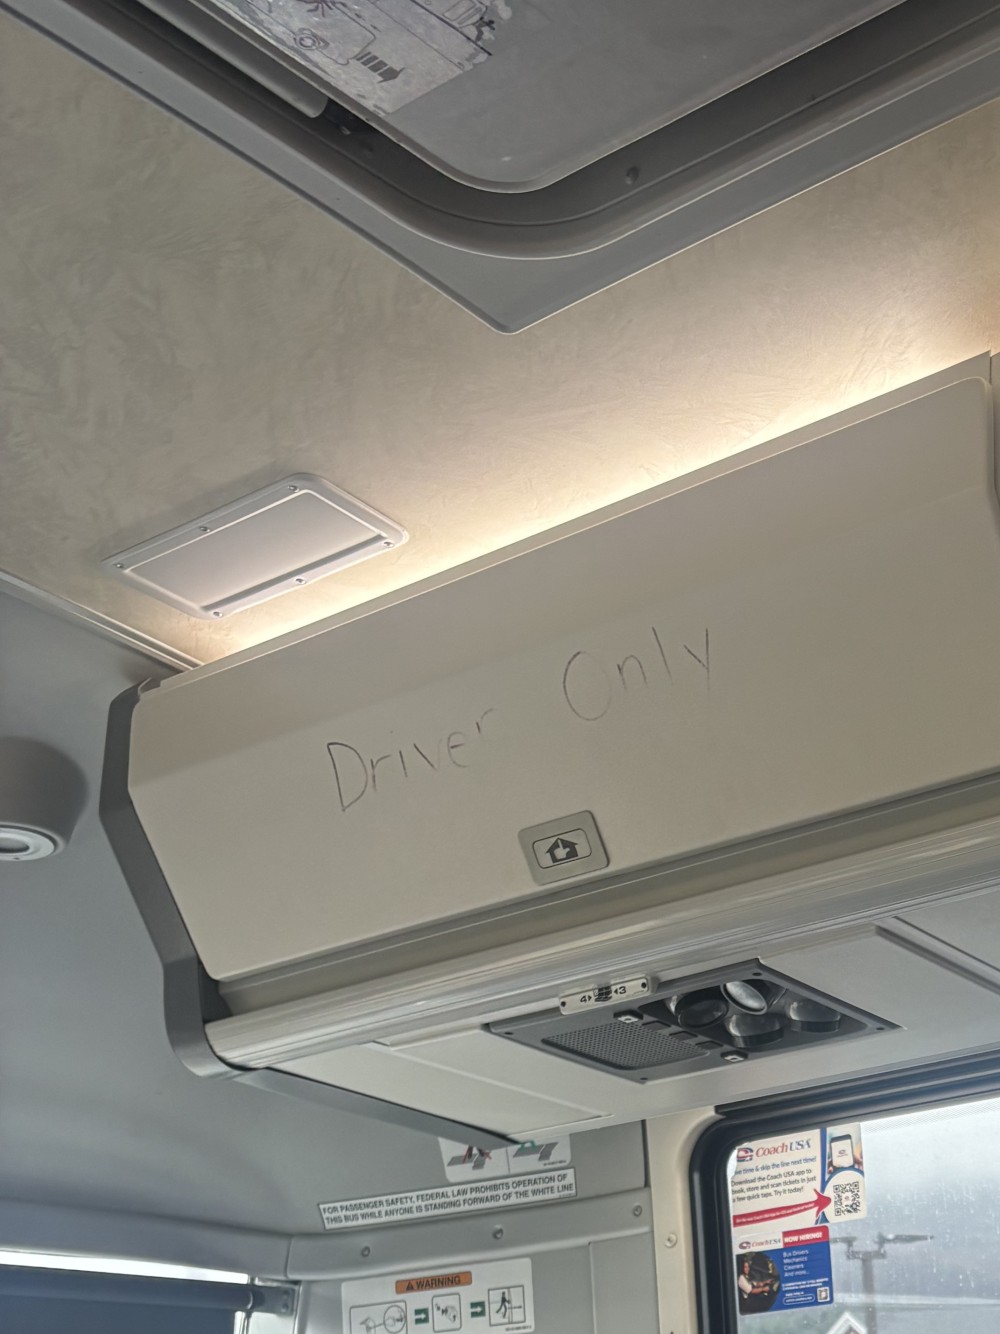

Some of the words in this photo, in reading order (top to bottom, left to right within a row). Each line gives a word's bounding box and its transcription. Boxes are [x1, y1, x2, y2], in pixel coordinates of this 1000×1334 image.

[326, 707, 500, 812] Driver
[562, 625, 711, 721] Only
[580, 995, 587, 1003] 4
[618, 986, 626, 994] 3
[756, 1143, 788, 1157] Coach
[790, 1139, 811, 1151] USA
[323, 1205, 339, 1214] FOR
[340, 1200, 384, 1212] PASSENGER
[385, 1196, 415, 1206] SAFETY,
[416, 1191, 450, 1202] FEDERAL
[452, 1186, 468, 1198] LAW
[470, 1182, 510, 1194] PROHIBITS
[512, 1175, 555, 1188] OPERATION
[557, 1173, 567, 1182] OF
[326, 1216, 343, 1224] THIS
[344, 1213, 359, 1222] BUS
[360, 1210, 384, 1220] WHILE
[385, 1206, 414, 1217] ANYONE
[424, 1200, 461, 1212] STANDING
[462, 1194, 500, 1206] FORWARD
[502, 1192, 512, 1201] OF
[515, 1190, 529, 1199] THE
[531, 1186, 555, 1197] WHITE
[557, 1183, 573, 1193] LINE
[800, 1232, 822, 1241] HIRING!
[416, 1274, 460, 1289] WARNING
